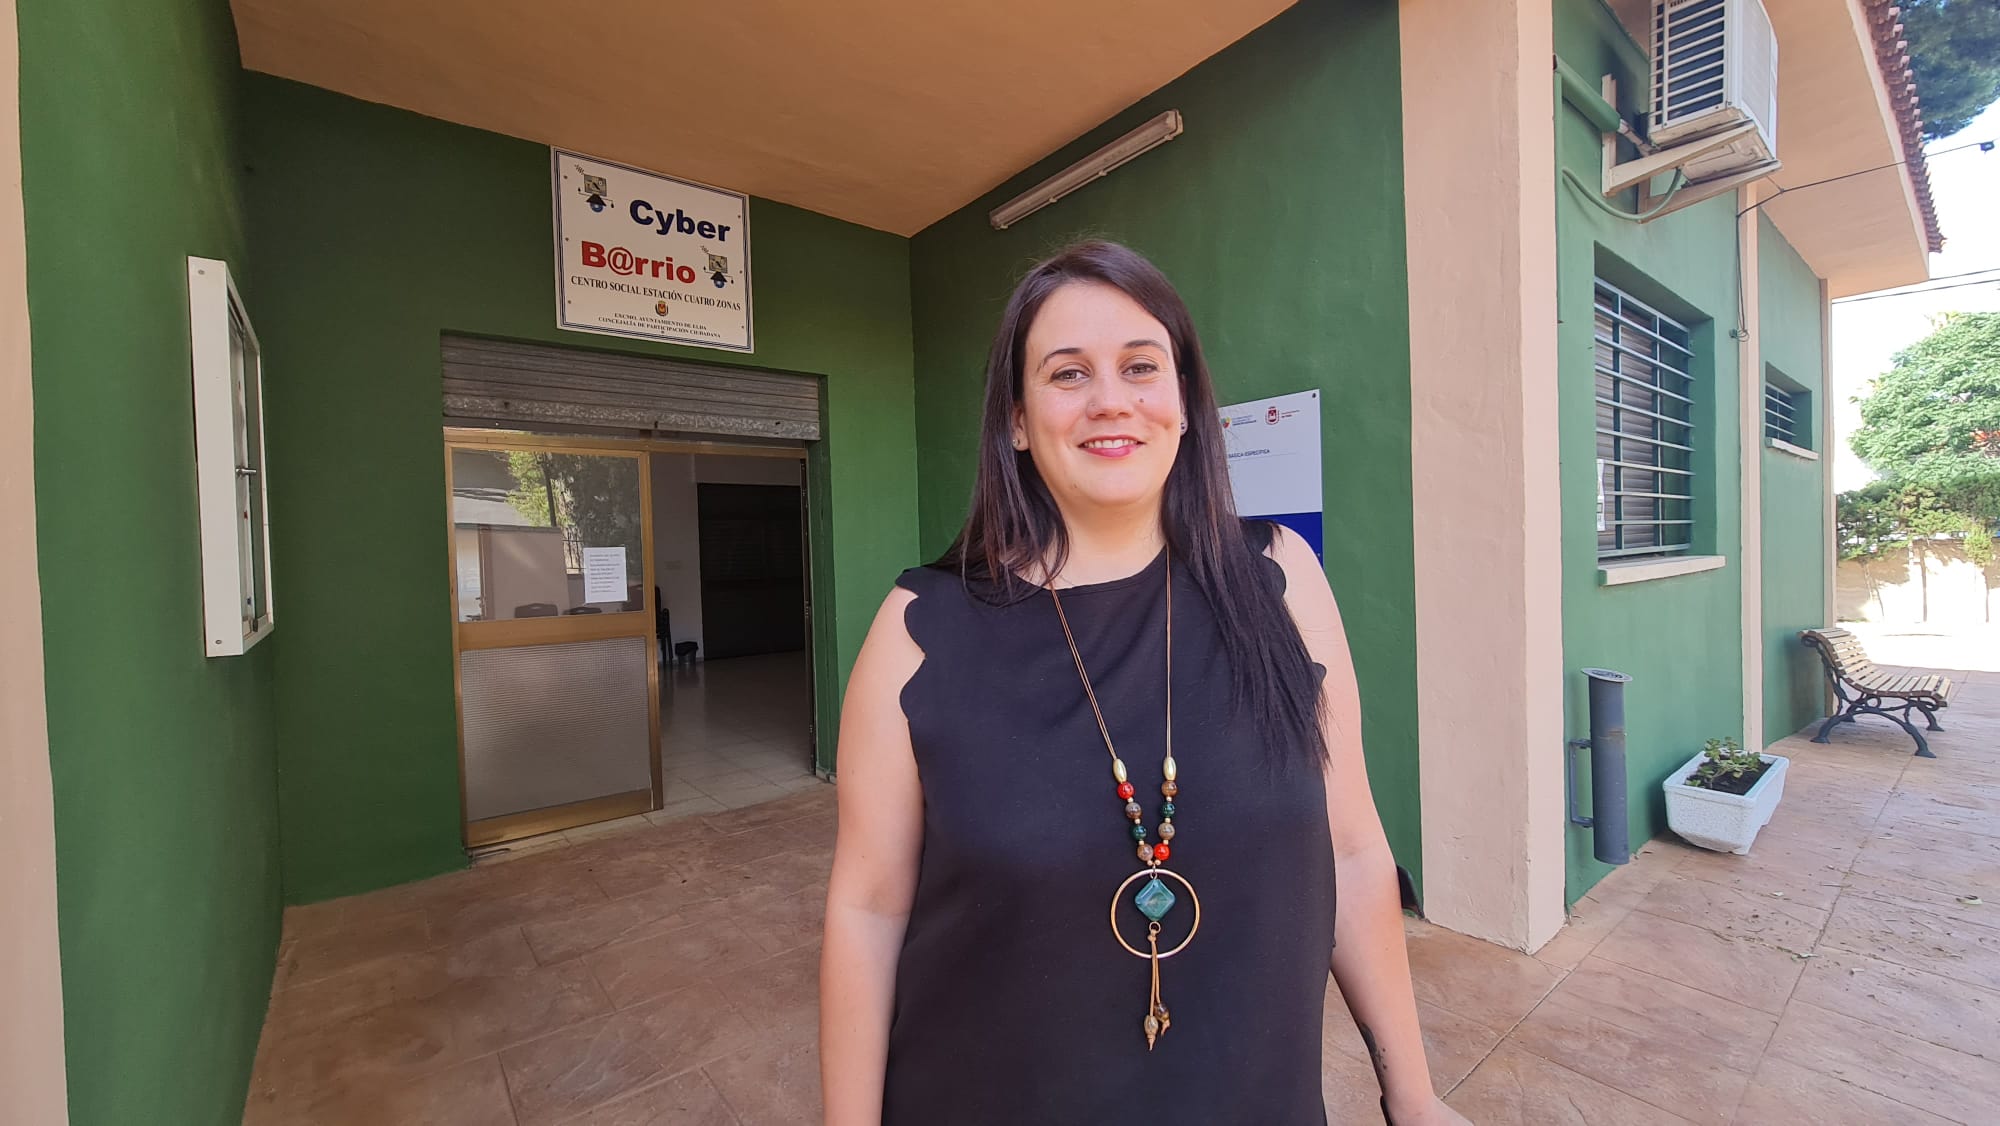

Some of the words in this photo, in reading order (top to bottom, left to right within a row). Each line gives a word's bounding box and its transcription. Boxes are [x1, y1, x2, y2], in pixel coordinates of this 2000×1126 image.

[629, 199, 731, 242] Cyber
[581, 240, 697, 284] B@rrio
[571, 275, 608, 290] CENTRO
[609, 281, 641, 295] SOCIAL
[643, 287, 682, 301] ESTACIÓN
[684, 294, 715, 307] CUATRO
[716, 299, 741, 311] ZONAS
[639, 316, 684, 327] AYUNTAMIENTO
[690, 329, 721, 338] CIUDADANA
